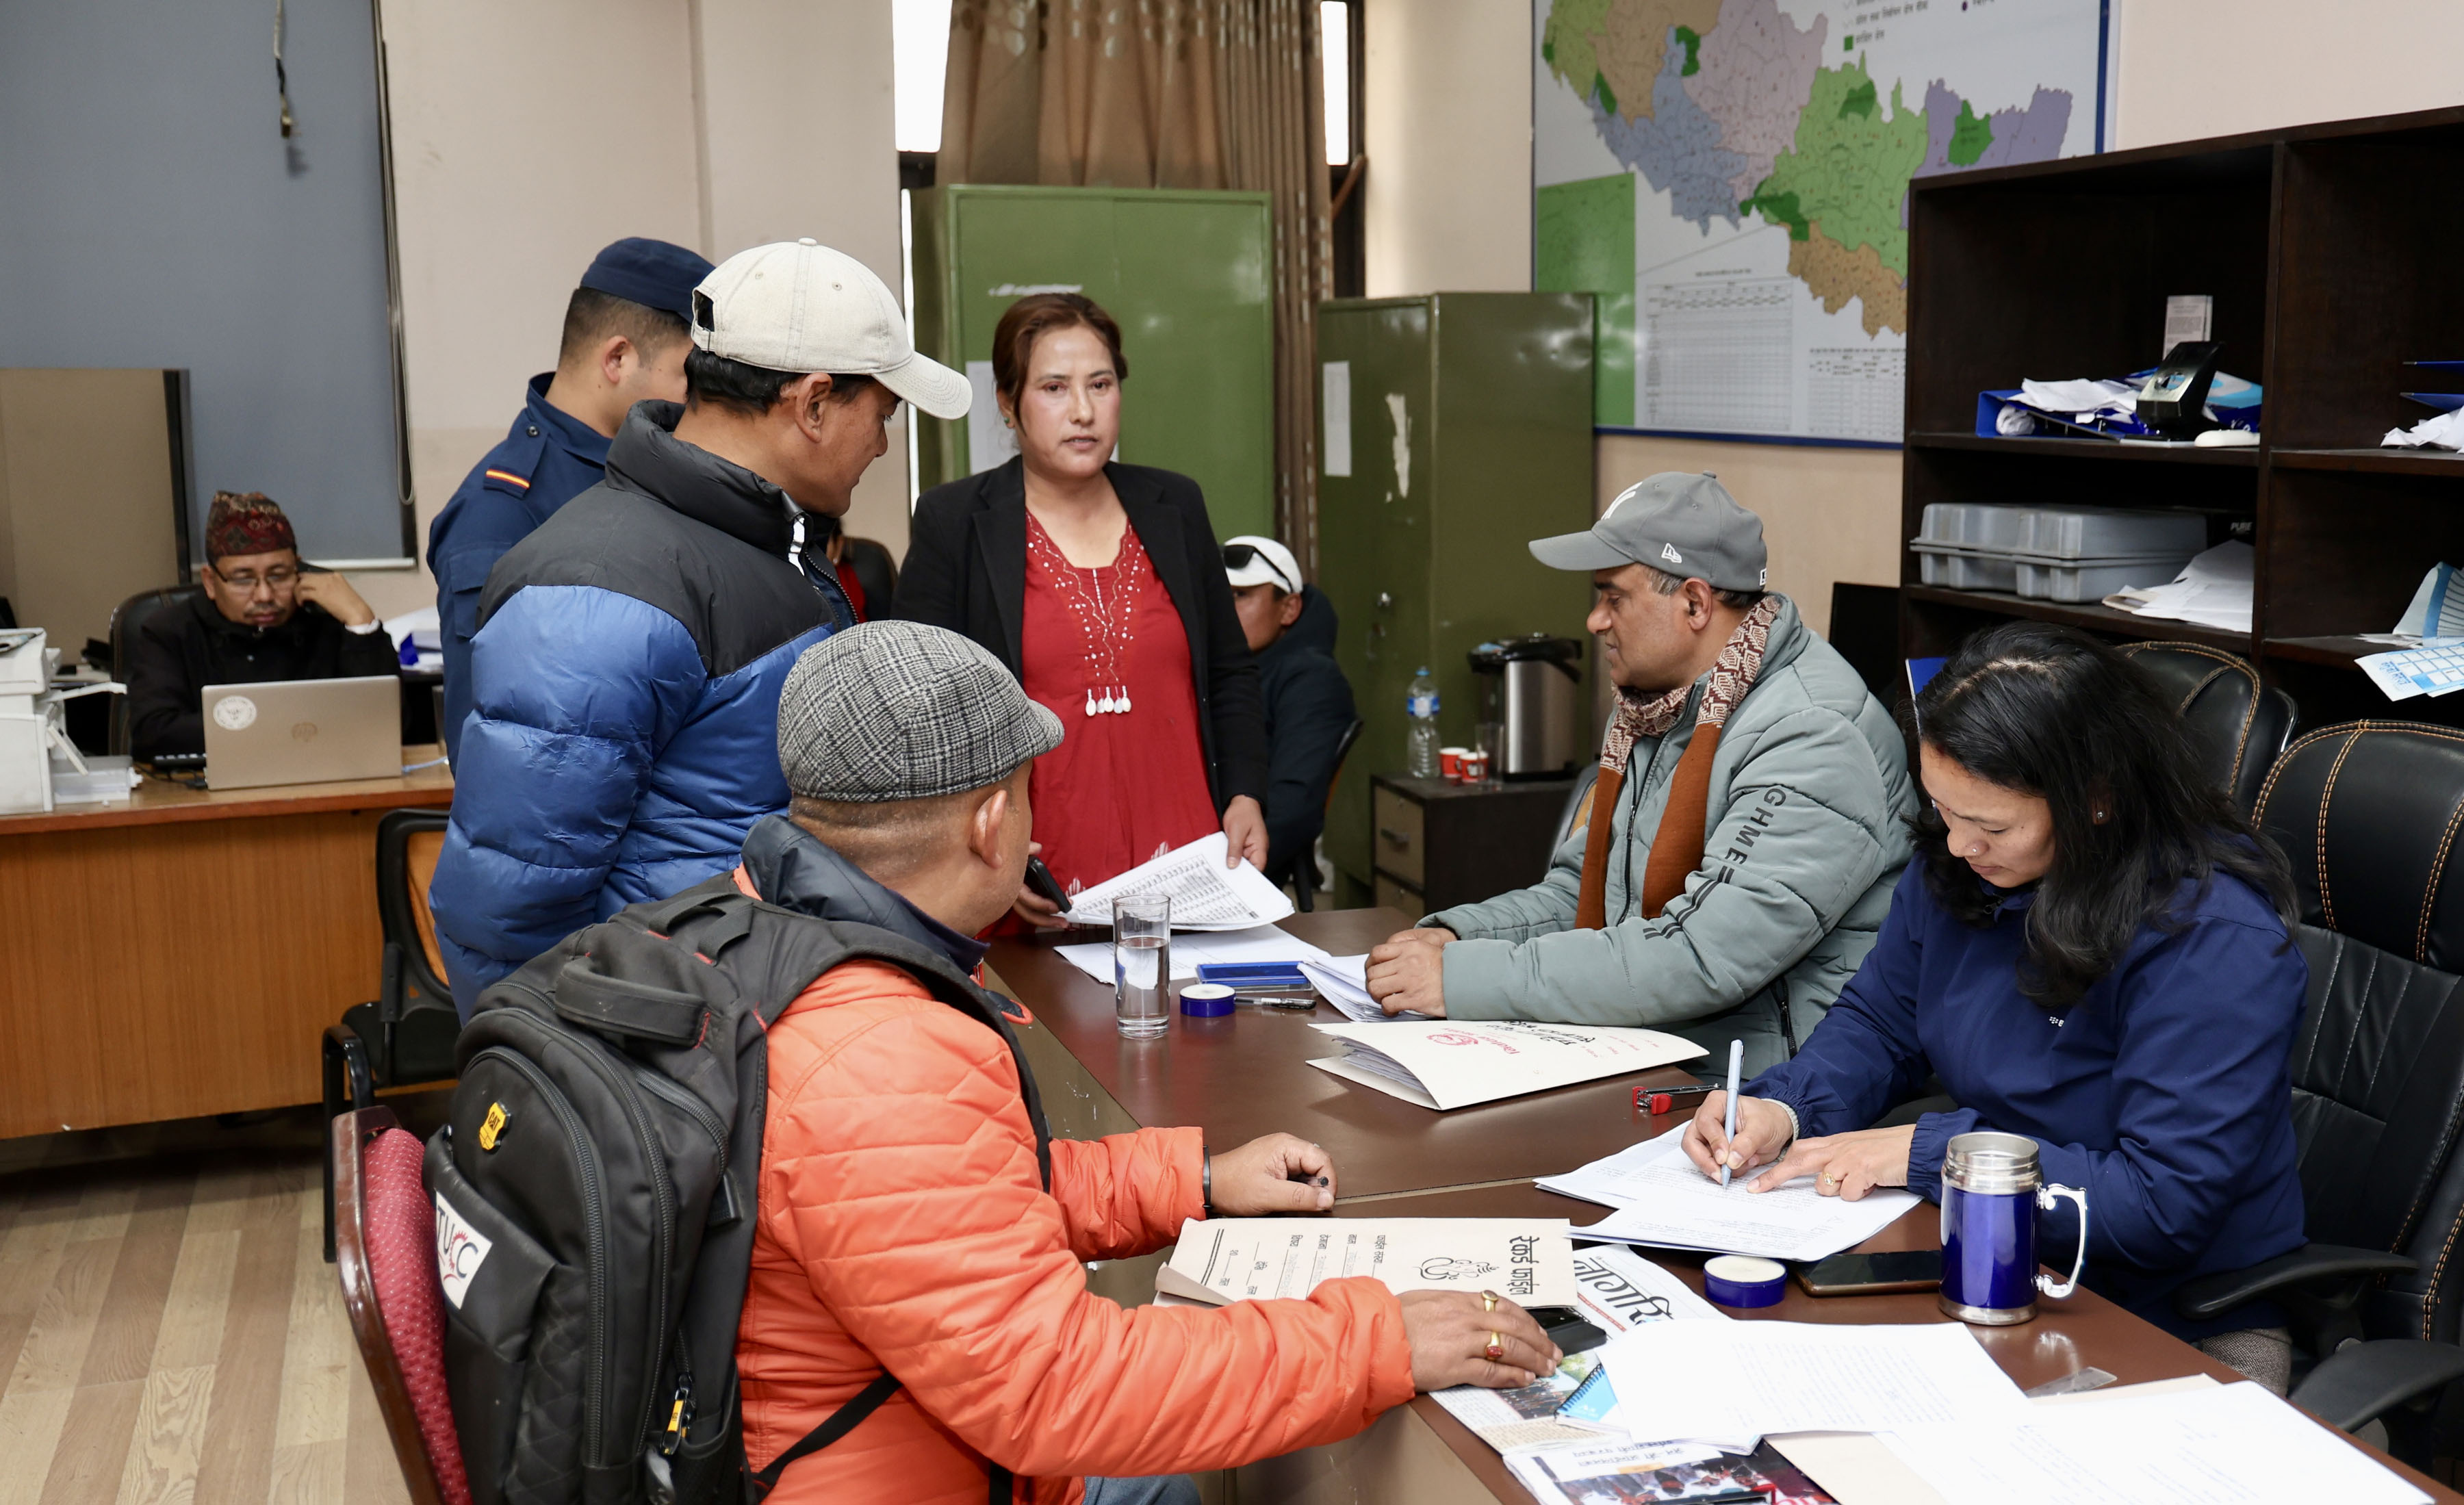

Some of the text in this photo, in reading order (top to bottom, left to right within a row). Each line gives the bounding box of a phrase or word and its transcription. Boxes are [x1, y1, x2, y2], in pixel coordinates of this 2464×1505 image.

[1723, 787, 1787, 865] GHME
[487, 1111, 501, 1131] CAT
[1346, 1234, 1358, 1244] नाम
[1509, 1235, 1540, 1264] रेकर्ड
